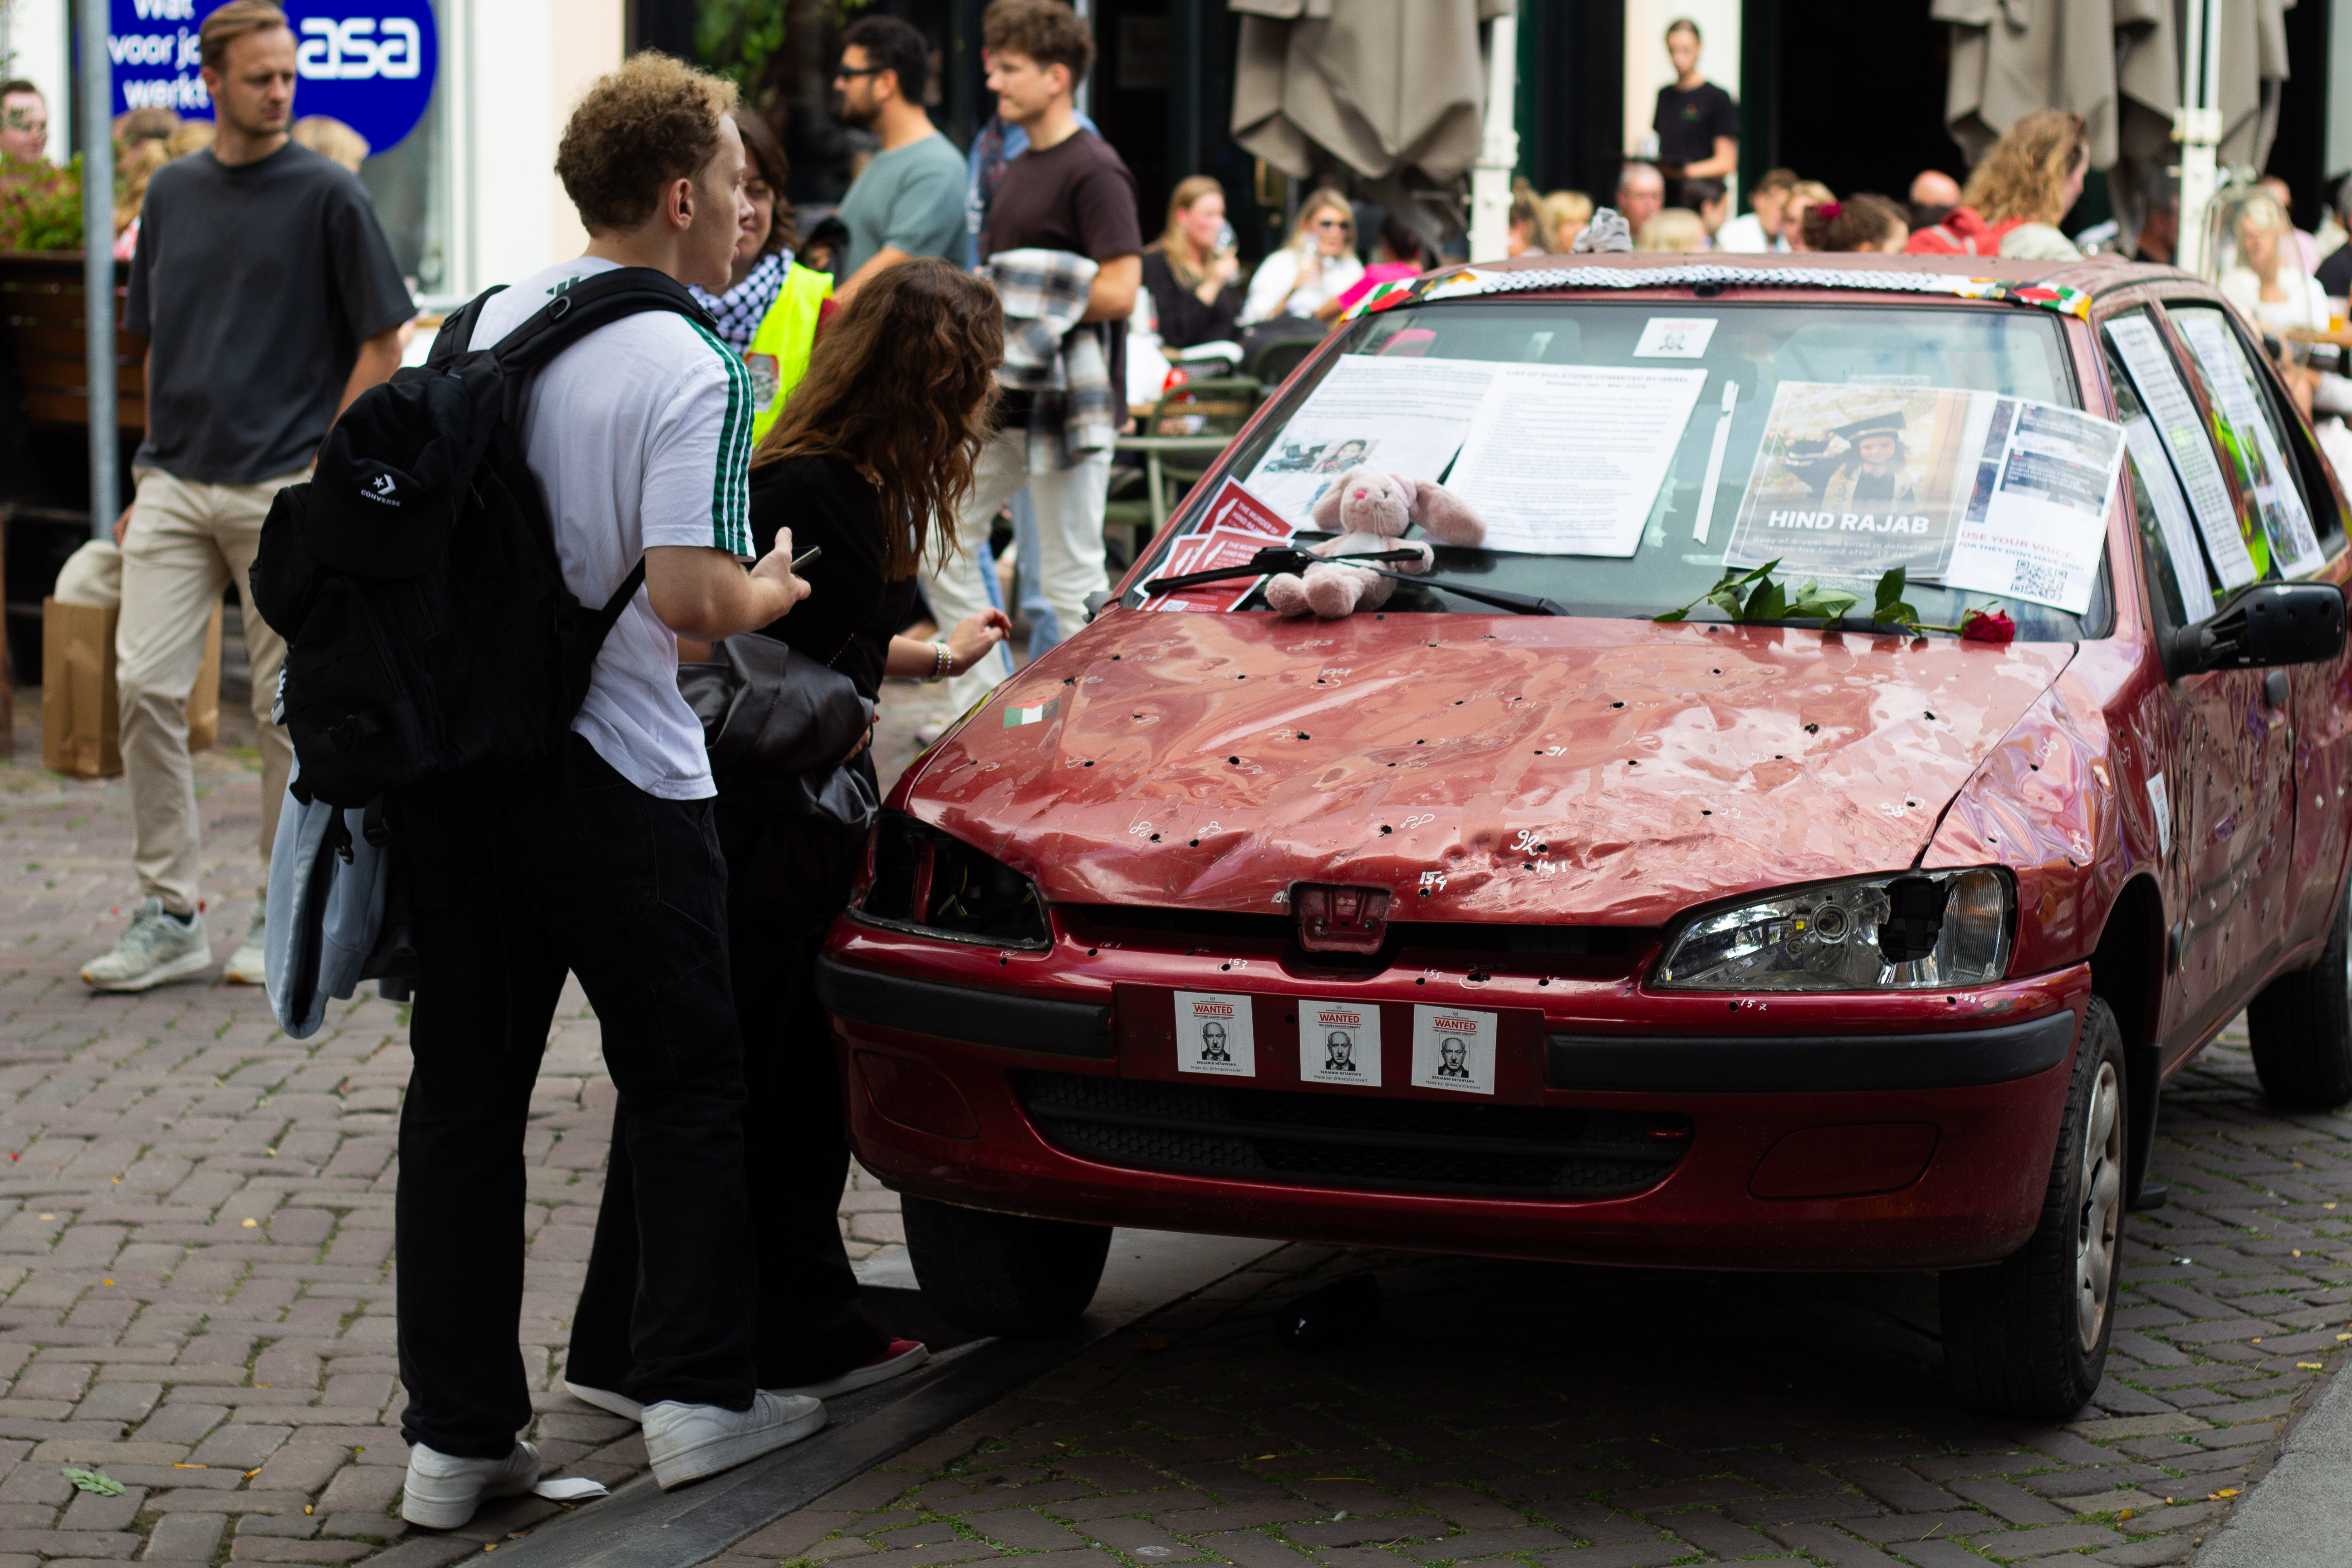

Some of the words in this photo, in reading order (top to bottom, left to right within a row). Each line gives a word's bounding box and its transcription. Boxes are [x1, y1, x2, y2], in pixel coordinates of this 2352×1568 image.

[107, 33, 173, 65] voor
[296, 17, 420, 79] asa
[124, 74, 210, 109] werkt
[361, 489, 401, 507] CONVERSE
[1768, 510, 1835, 530] HIND
[1840, 513, 1930, 534] RAJAB
[1962, 531, 1987, 541] USE
[1991, 535, 2028, 549] YOUR
[1980, 544, 2003, 553] THEY
[2034, 554, 2058, 564] HAVE
[1400, 813, 1435, 829] 88
[1510, 830, 1539, 856] 92
[1228, 958, 1248, 970] 153
[1194, 1004, 1233, 1014] WANTED
[1319, 1013, 1360, 1023] WANTED
[1435, 1019, 1476, 1030] WANTED
[1445, 1082, 1480, 1090] @thedutchrevert
